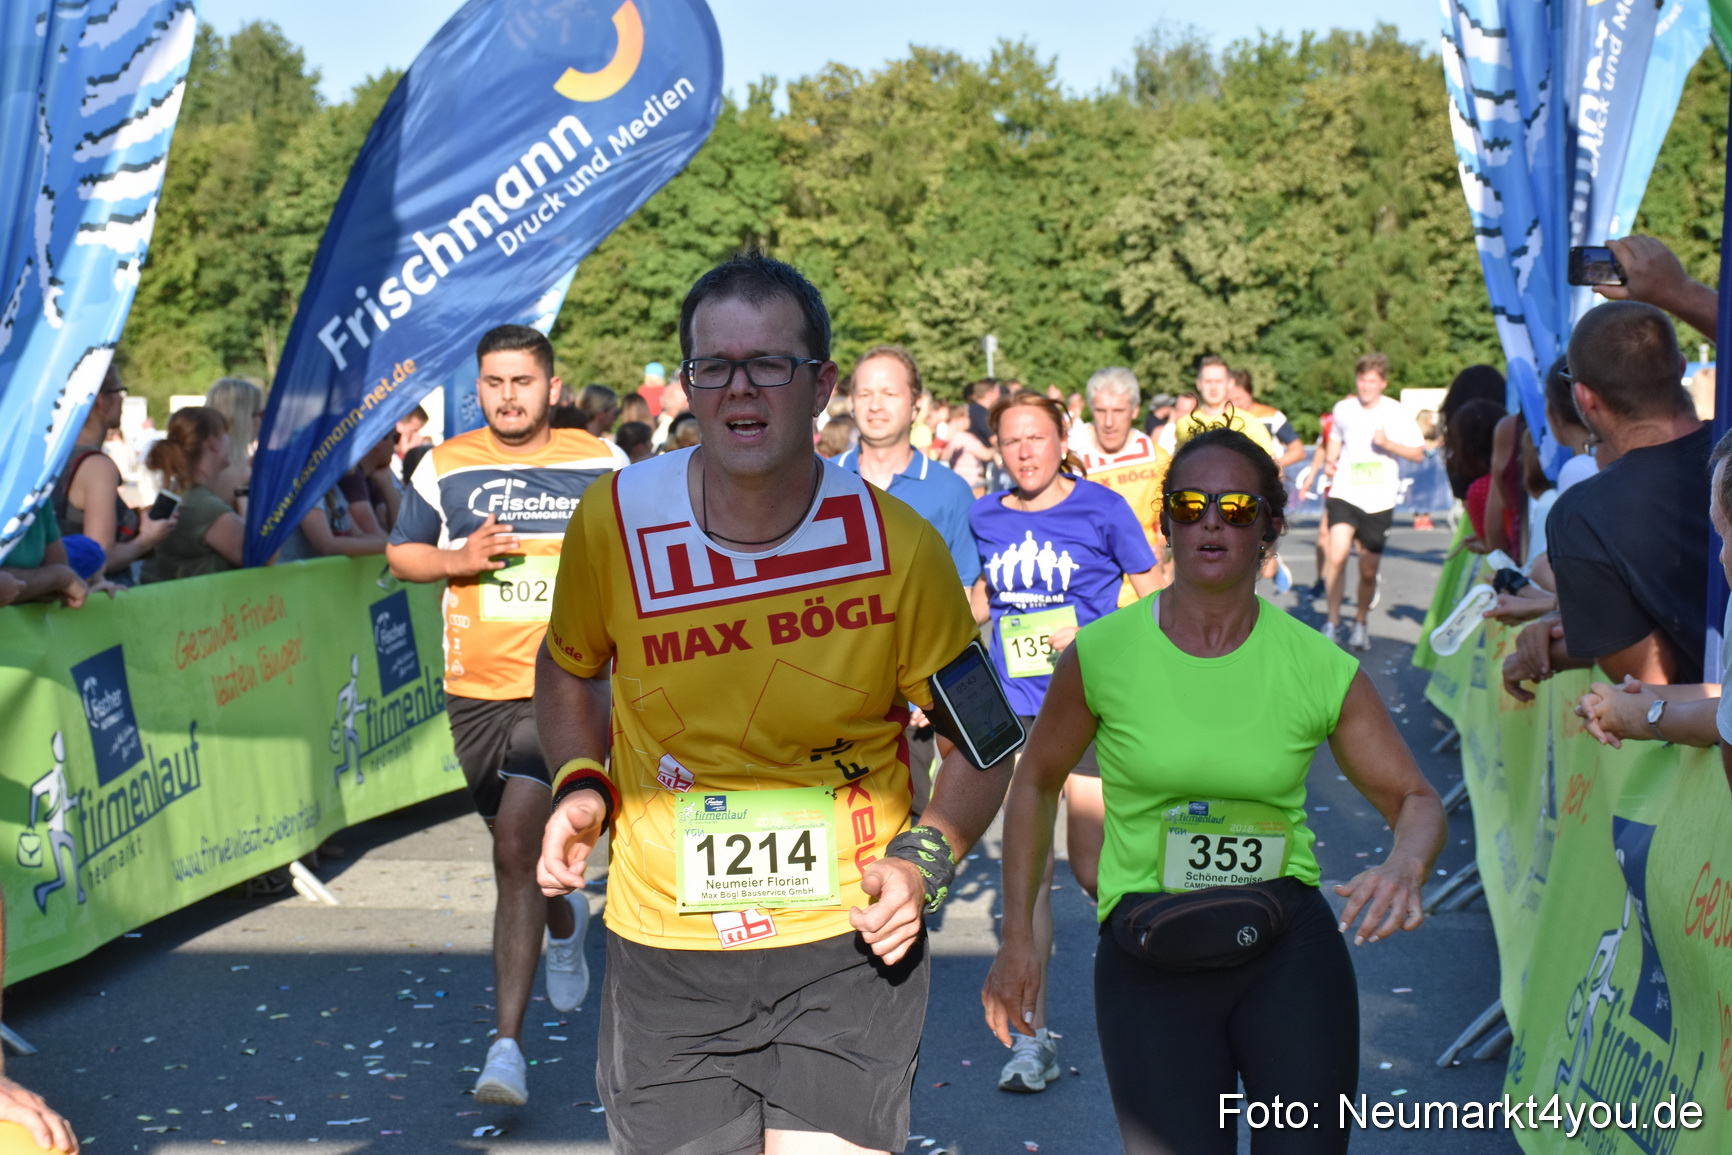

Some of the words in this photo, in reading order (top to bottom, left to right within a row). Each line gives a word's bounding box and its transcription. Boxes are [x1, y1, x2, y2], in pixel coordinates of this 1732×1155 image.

[1602, 33, 1623, 91] und
[495, 190, 566, 257] Druck
[564, 148, 611, 197] und
[608, 77, 694, 157] Medien
[317, 115, 593, 371] Frischmann
[488, 492, 580, 512] Fischer
[500, 581, 548, 602] 602
[642, 619, 753, 667] MAX
[767, 594, 896, 646] BÖGL
[1012, 634, 1053, 659] 135
[367, 665, 446, 755] firmenla
[78, 719, 201, 862] firmenlauf
[695, 809, 748, 820] firmenlauf
[1178, 811, 1225, 825] firmenlauf
[696, 829, 817, 876] 1214
[1188, 834, 1263, 873] 353
[706, 879, 764, 889] Neumeier
[767, 876, 809, 887] Florian
[720, 889, 739, 900] Bögl
[742, 888, 786, 898] Bauservice
[789, 887, 814, 895] GmbH
[1185, 872, 1228, 883] Schöner
[1231, 874, 1263, 884] Denise
